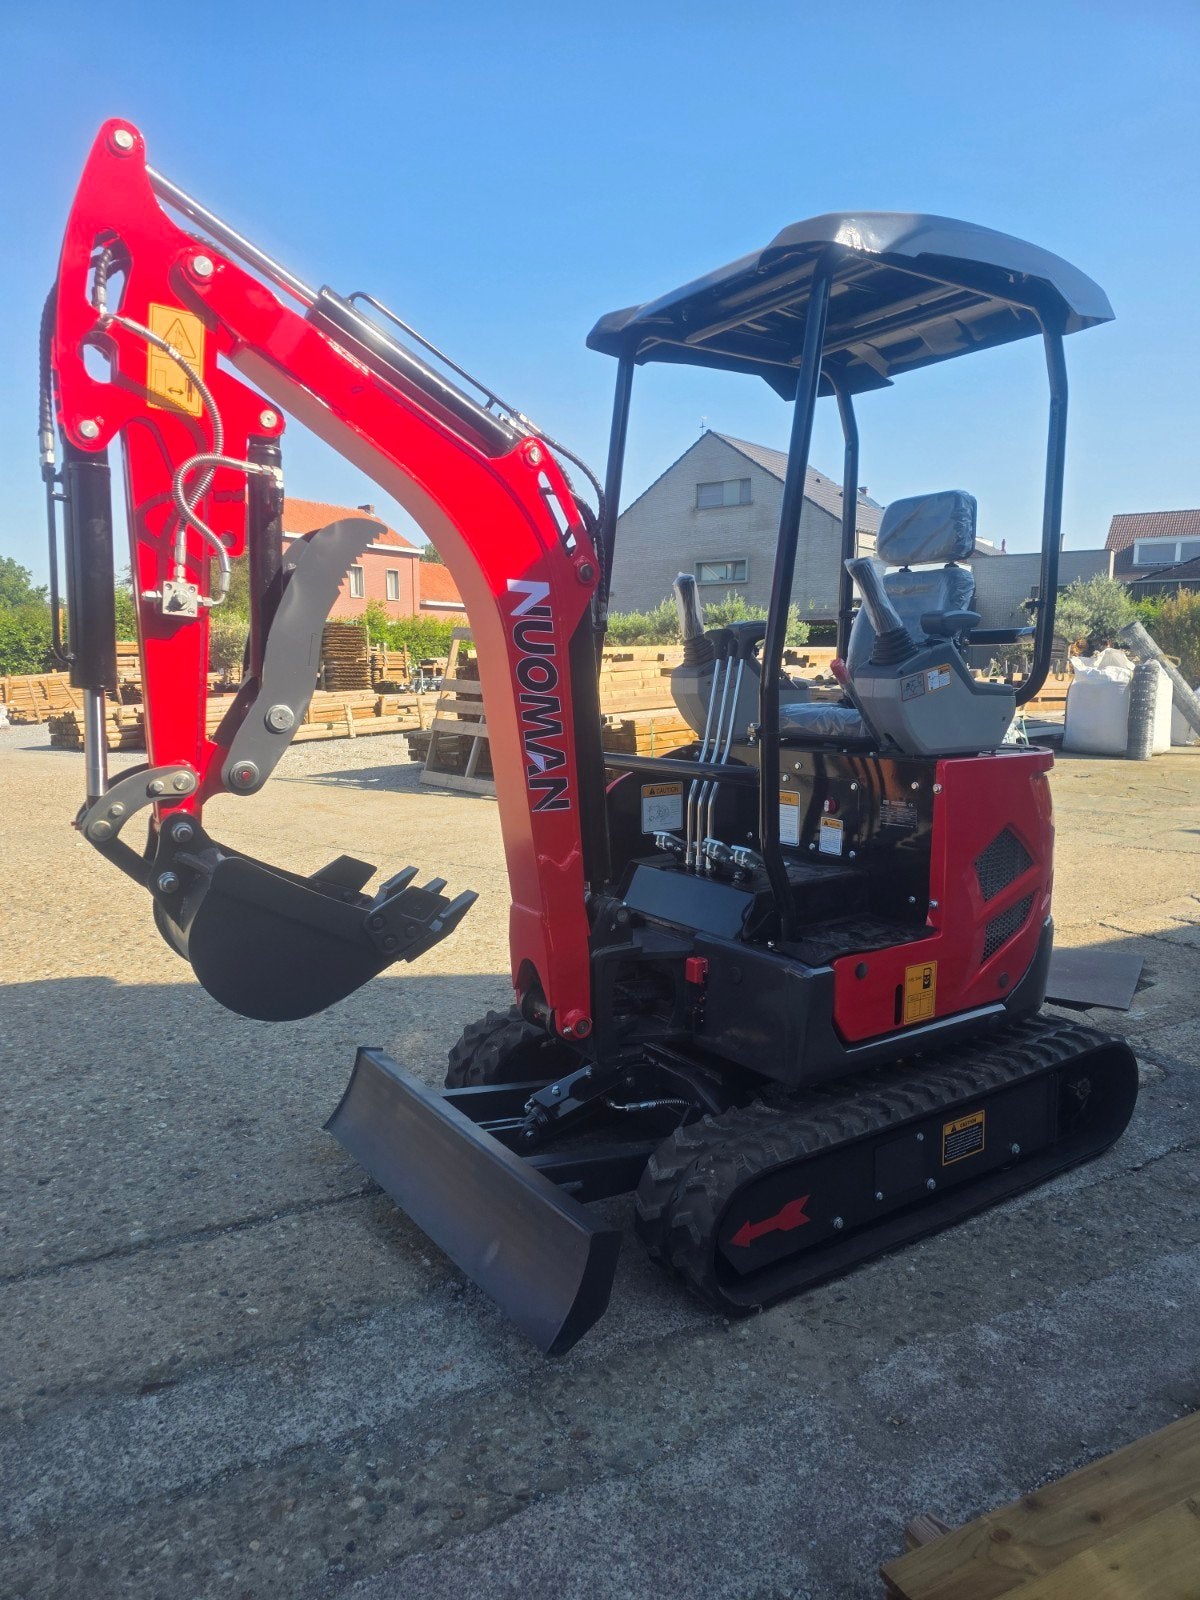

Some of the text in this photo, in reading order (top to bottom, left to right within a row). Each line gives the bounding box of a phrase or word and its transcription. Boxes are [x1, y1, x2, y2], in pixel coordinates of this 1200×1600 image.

[507, 579, 571, 812] NUOMAN
[656, 786, 679, 794] CAUTION
[960, 1117, 977, 1129] CAUTION
